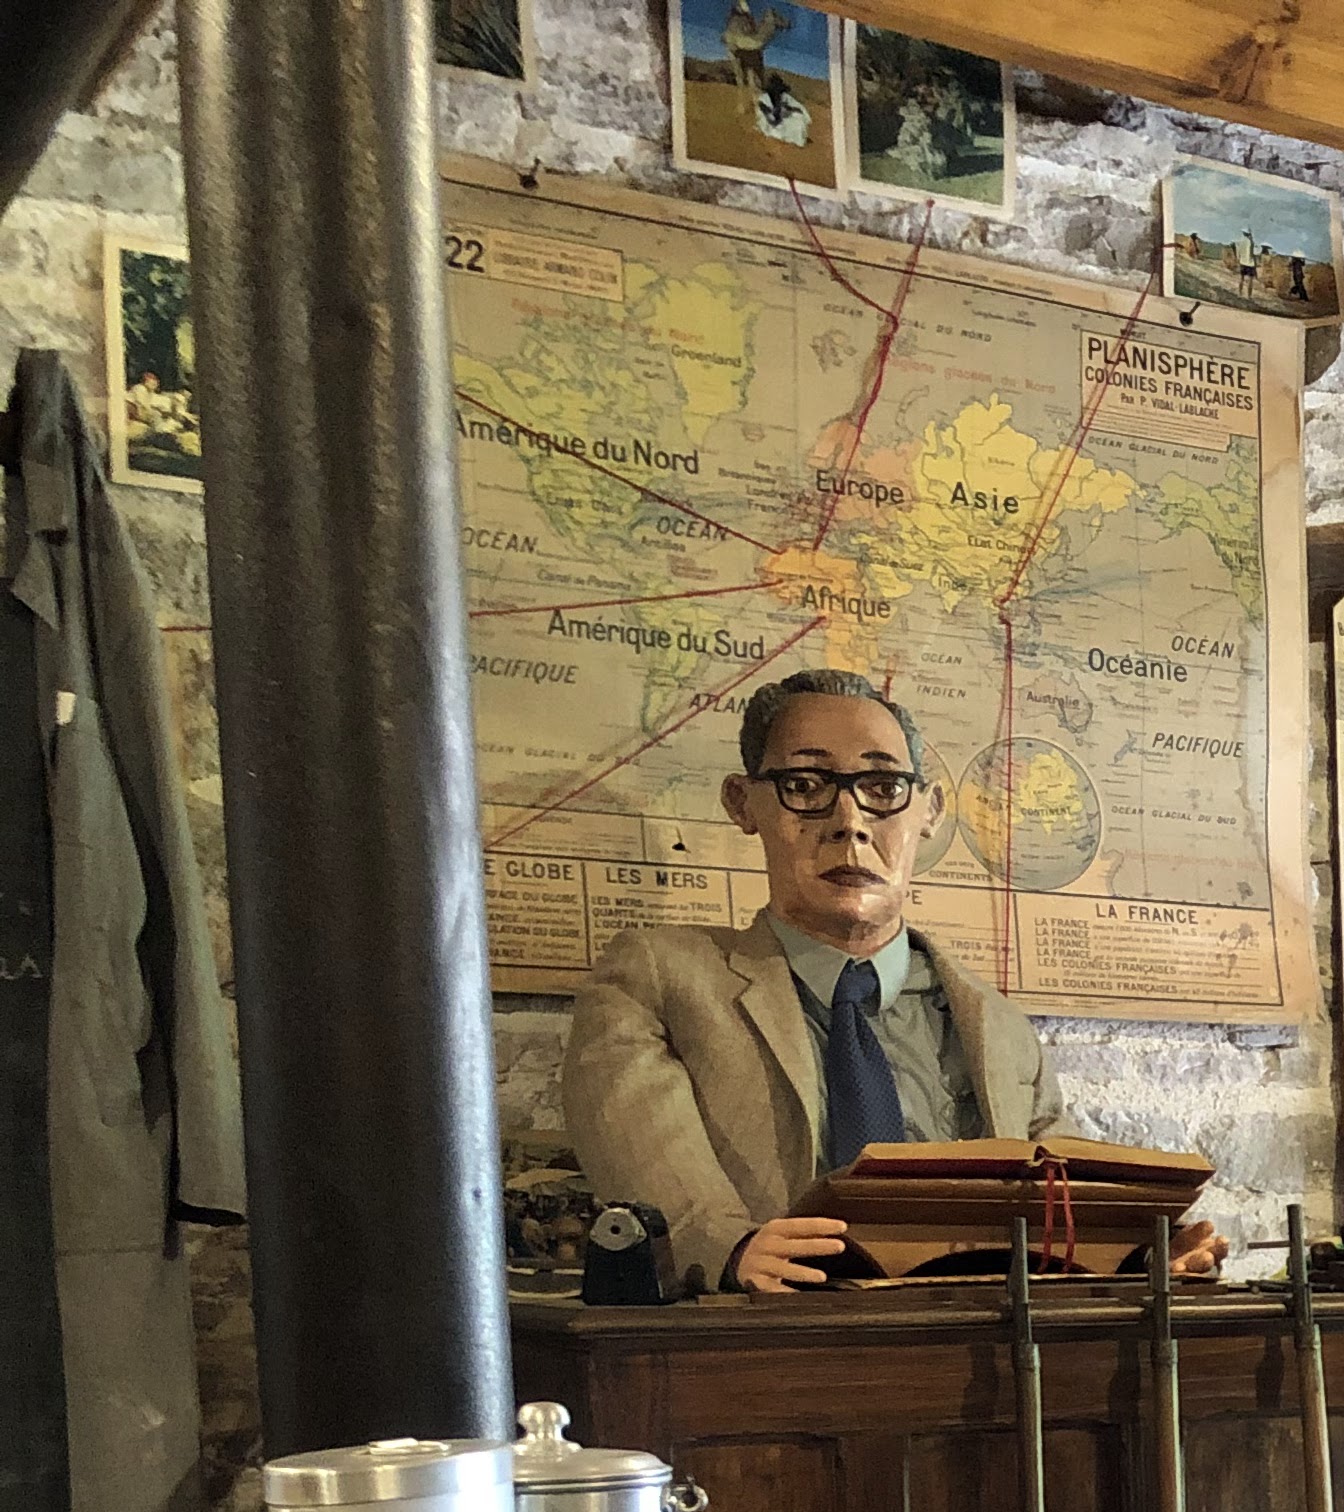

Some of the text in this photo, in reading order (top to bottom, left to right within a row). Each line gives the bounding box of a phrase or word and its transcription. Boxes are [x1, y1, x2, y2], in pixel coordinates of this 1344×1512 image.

[445, 235, 485, 273] 22
[671, 344, 742, 368] Groenland
[1088, 337, 1251, 391] PLANISPHÈRE
[1085, 365, 1254, 411] COLONIES FRANÇAISES
[593, 436, 627, 463] du
[633, 439, 700, 474] Nord
[1172, 450, 1186, 459] DU
[1191, 453, 1219, 465] NORD
[816, 469, 904, 508] Europe
[950, 481, 1020, 514] Asie
[802, 584, 891, 624] Afrique
[547, 608, 765, 660] Amérique du Sud
[1171, 634, 1236, 659] OCÉAN
[1088, 647, 1188, 683] Océanie
[916, 684, 967, 698] INDIEN
[1026, 691, 1080, 709] Australie
[689, 693, 751, 714] ATLAN
[1152, 732, 1245, 758] PACIFIQUE
[484, 859, 575, 881] E GLOBE
[605, 866, 708, 890] LES MERS
[591, 896, 611, 906] LES
[616, 897, 645, 908] MERS
[1034, 917, 1049, 927] LA
[1050, 918, 1090, 930] FRANCE
[1095, 903, 1199, 925] LA FRANCE
[1035, 927, 1049, 938] LA
[1051, 928, 1090, 940] FRANCE
[1035, 937, 1091, 950] LA FRANCE
[1036, 947, 1050, 957] LA
[1052, 949, 1092, 960] FRANCE
[1036, 958, 1057, 968] LES
[1061, 959, 1112, 971] COLONIES
[1116, 962, 1177, 976] FRANÇAISES
[1038, 977, 1058, 988] LES
[1062, 978, 1113, 991] COLONIES
[1117, 980, 1178, 995] FRANÇAISES
